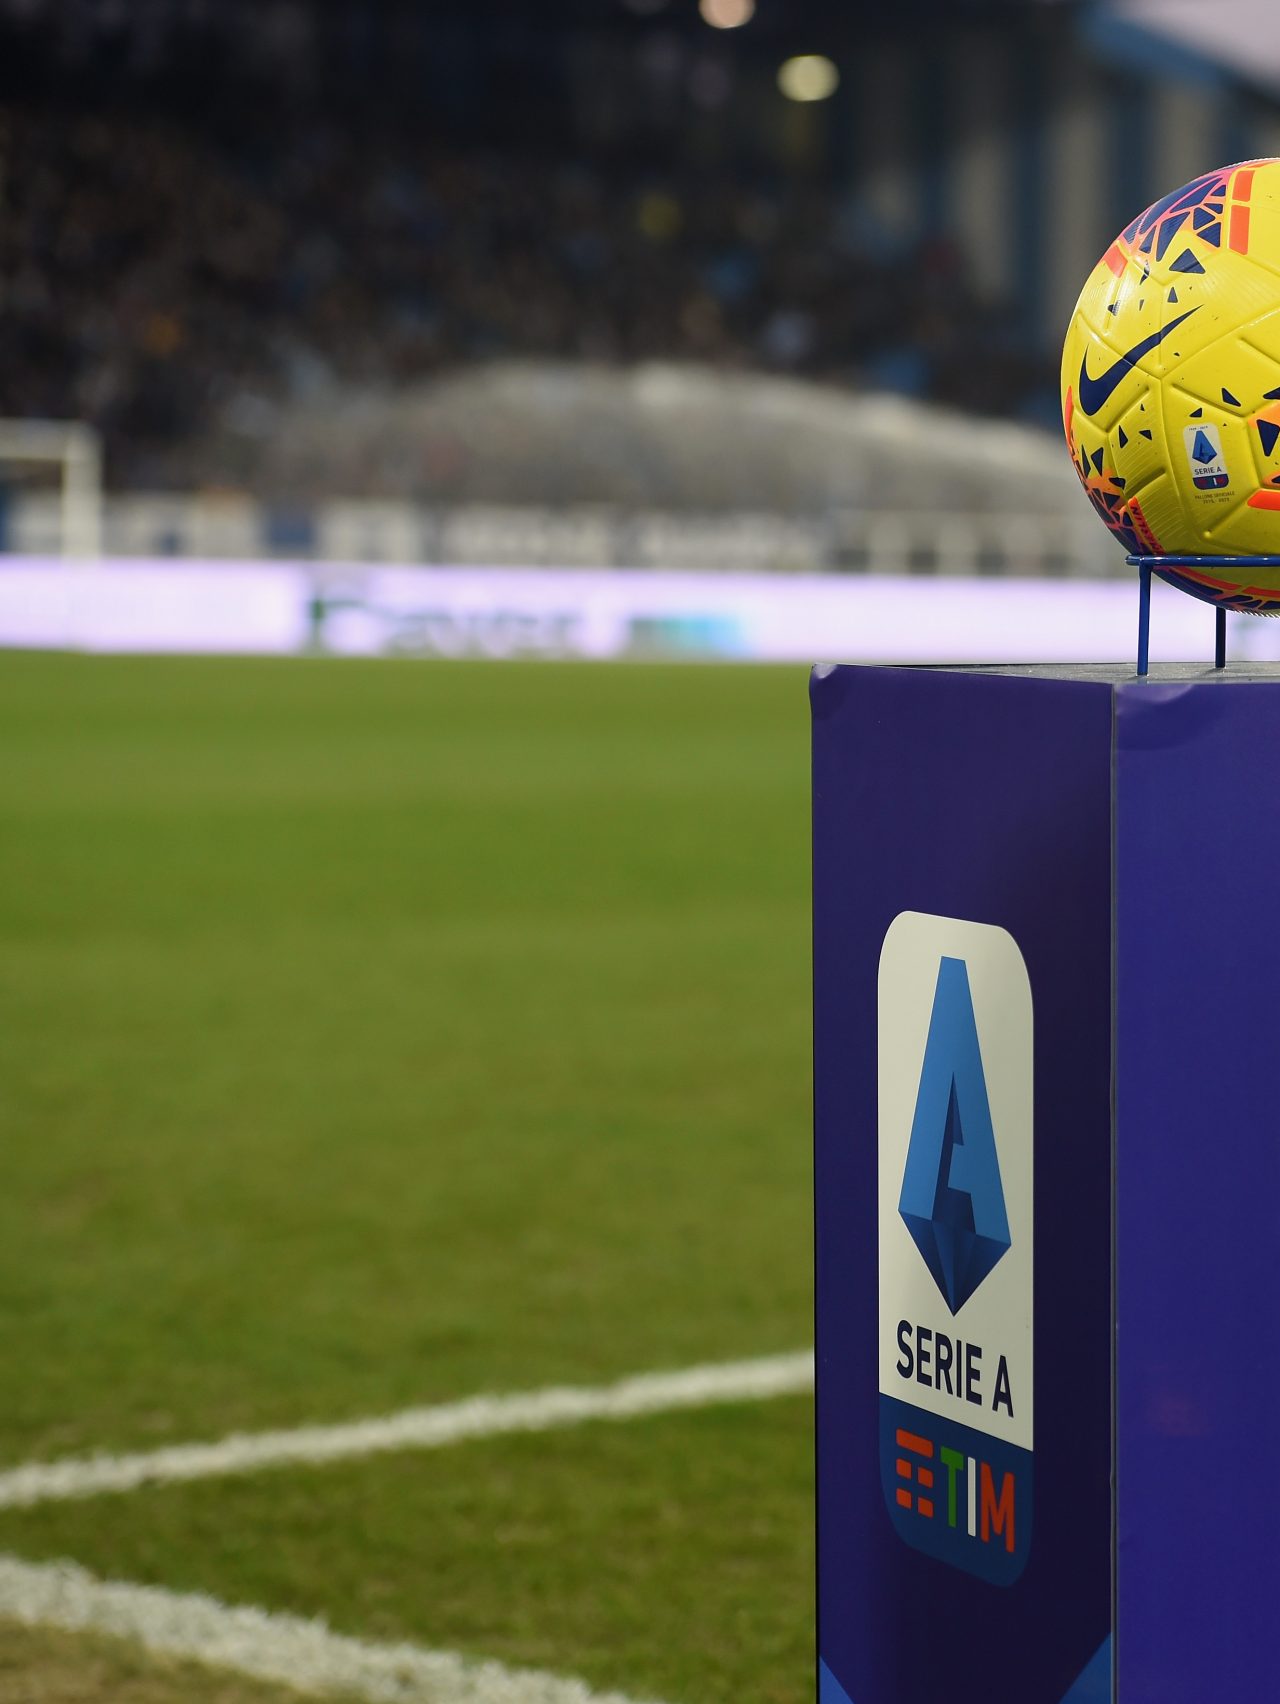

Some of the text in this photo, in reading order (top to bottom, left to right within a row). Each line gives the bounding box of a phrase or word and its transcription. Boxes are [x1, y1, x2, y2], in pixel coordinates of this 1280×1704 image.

[1194, 466, 1215, 476] SERIE
[896, 1319, 1015, 1419] SERIE A
[940, 1445, 1015, 1553] TIM
